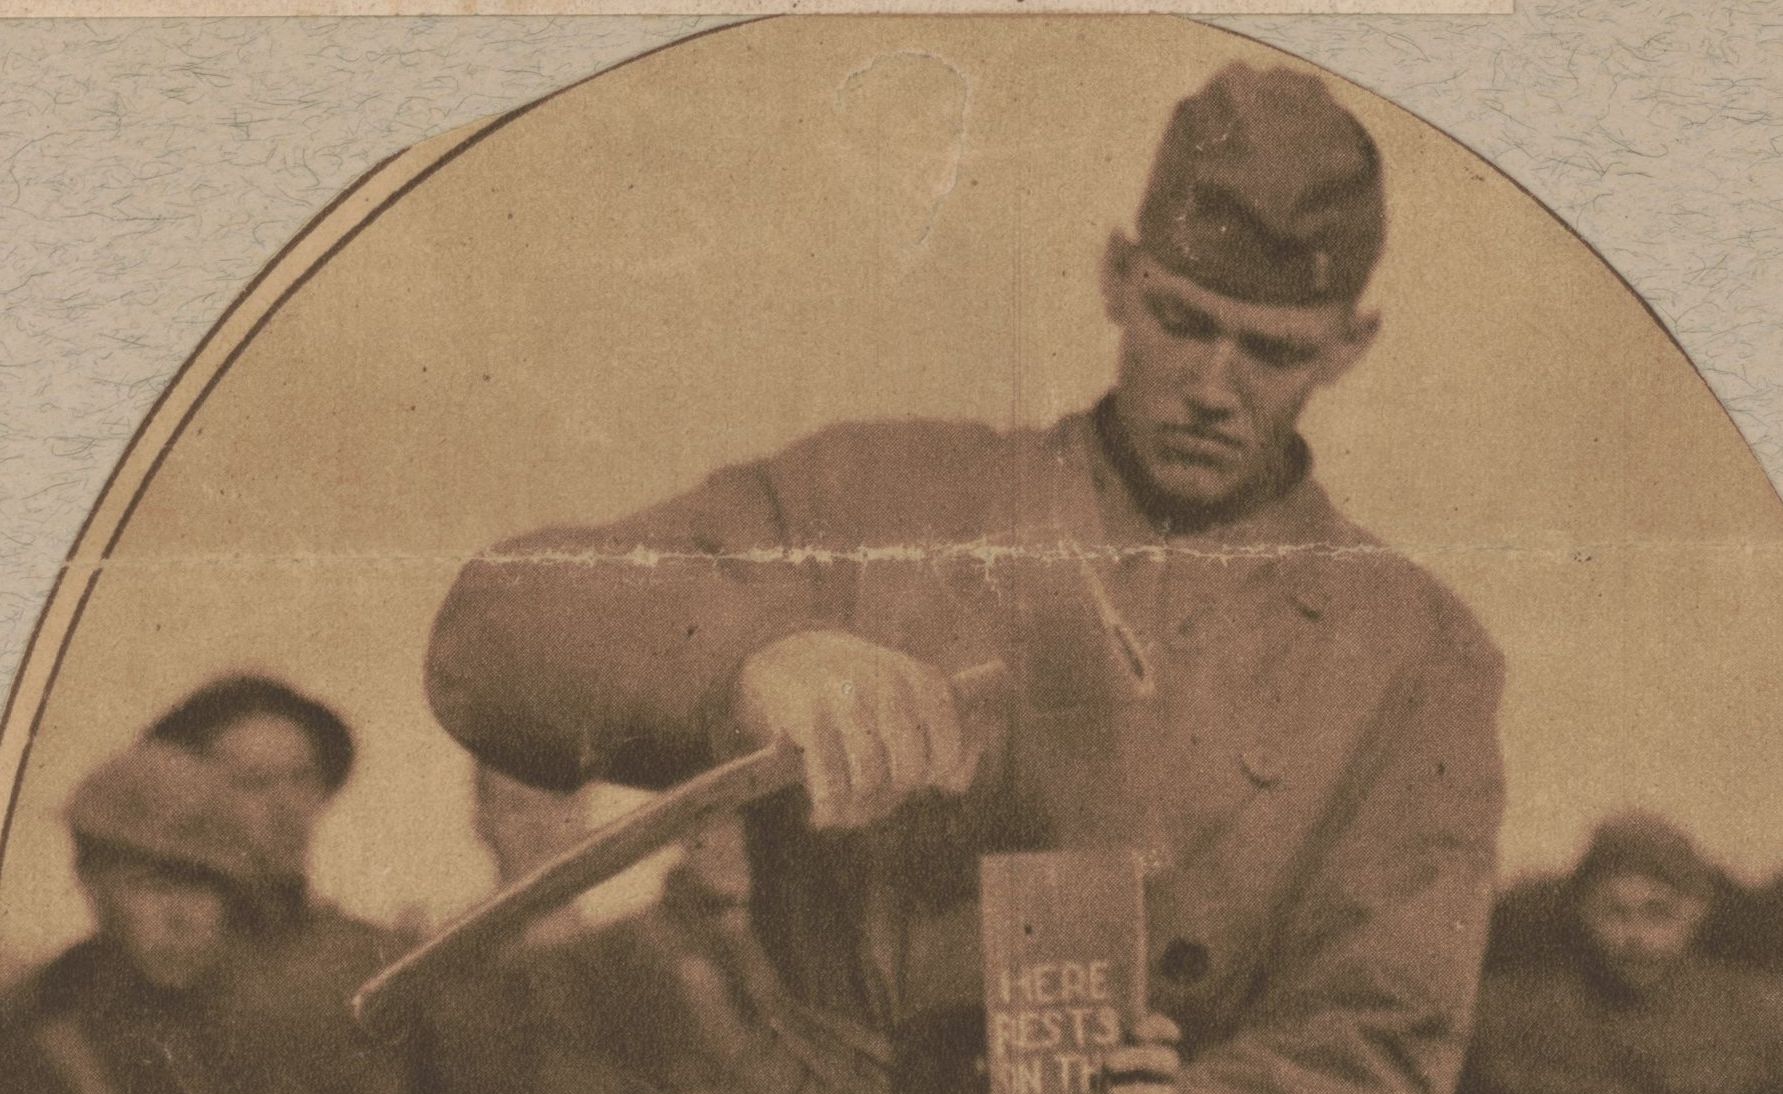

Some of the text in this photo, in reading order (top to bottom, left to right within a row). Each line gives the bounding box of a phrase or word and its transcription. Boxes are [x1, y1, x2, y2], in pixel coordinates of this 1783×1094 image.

[998, 958, 1109, 1003] HERE
[993, 1005, 1120, 1055] RESTS
[1055, 1053, 1104, 1094] TH
